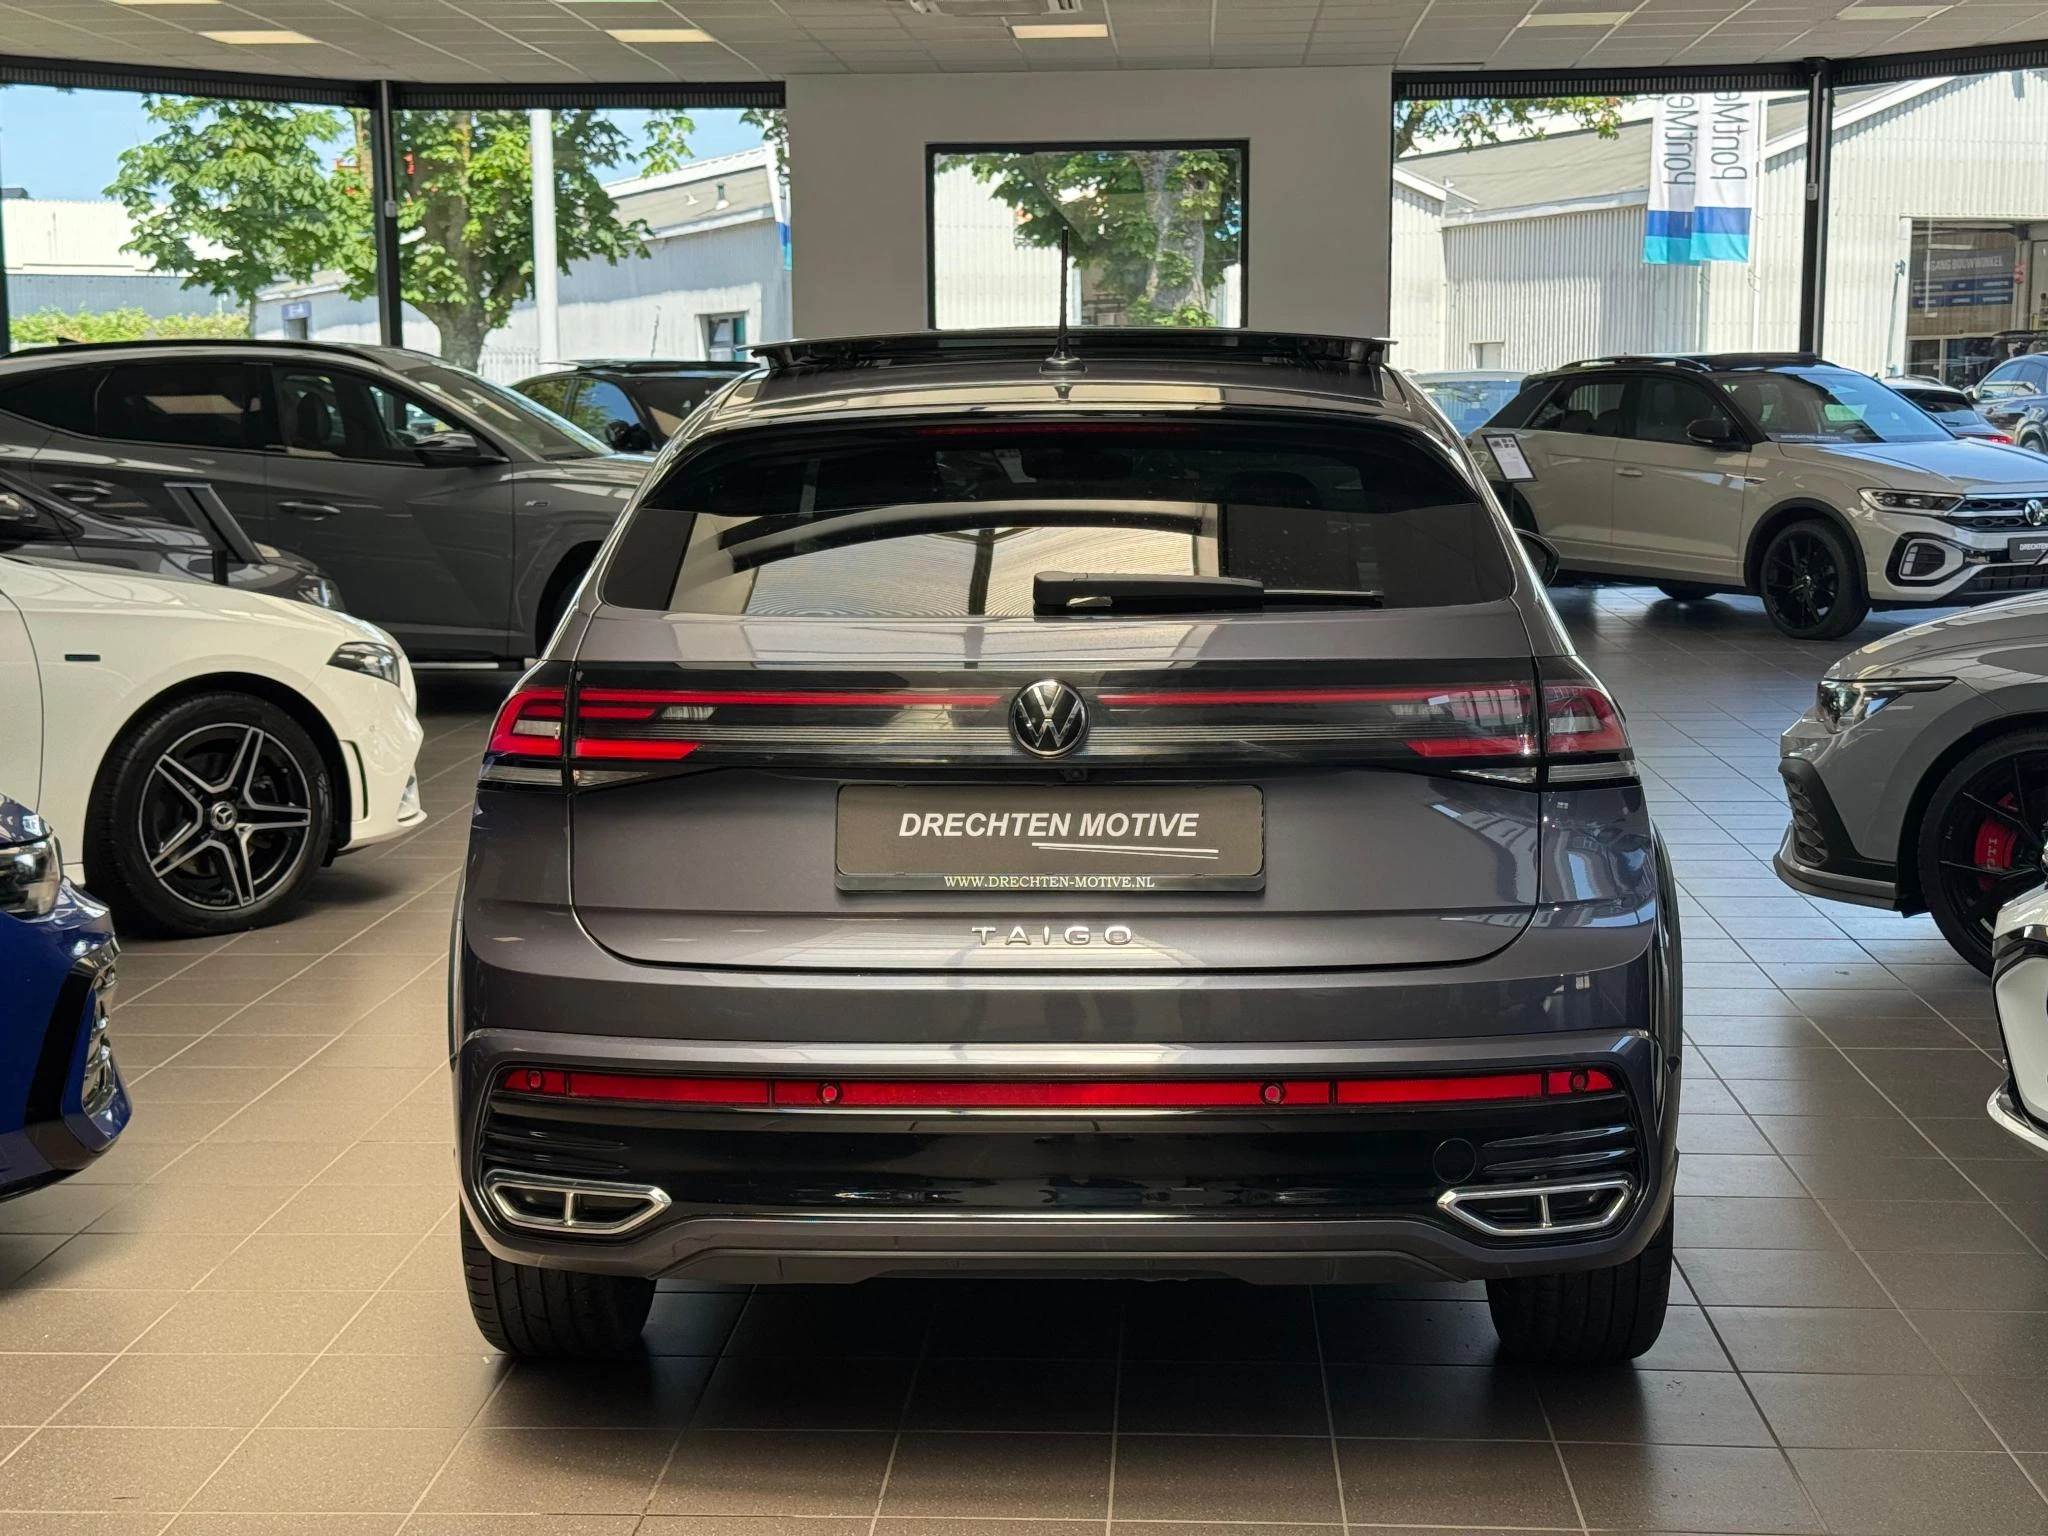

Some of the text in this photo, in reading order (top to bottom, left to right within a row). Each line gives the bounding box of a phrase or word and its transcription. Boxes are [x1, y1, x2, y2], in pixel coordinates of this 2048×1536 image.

[899, 812, 1200, 837] DRECHTEN MOTIVE
[944, 874, 1155, 889] WWW.DRECHTEN-MOTIVE.NL
[972, 925, 1134, 946] TAIGO
